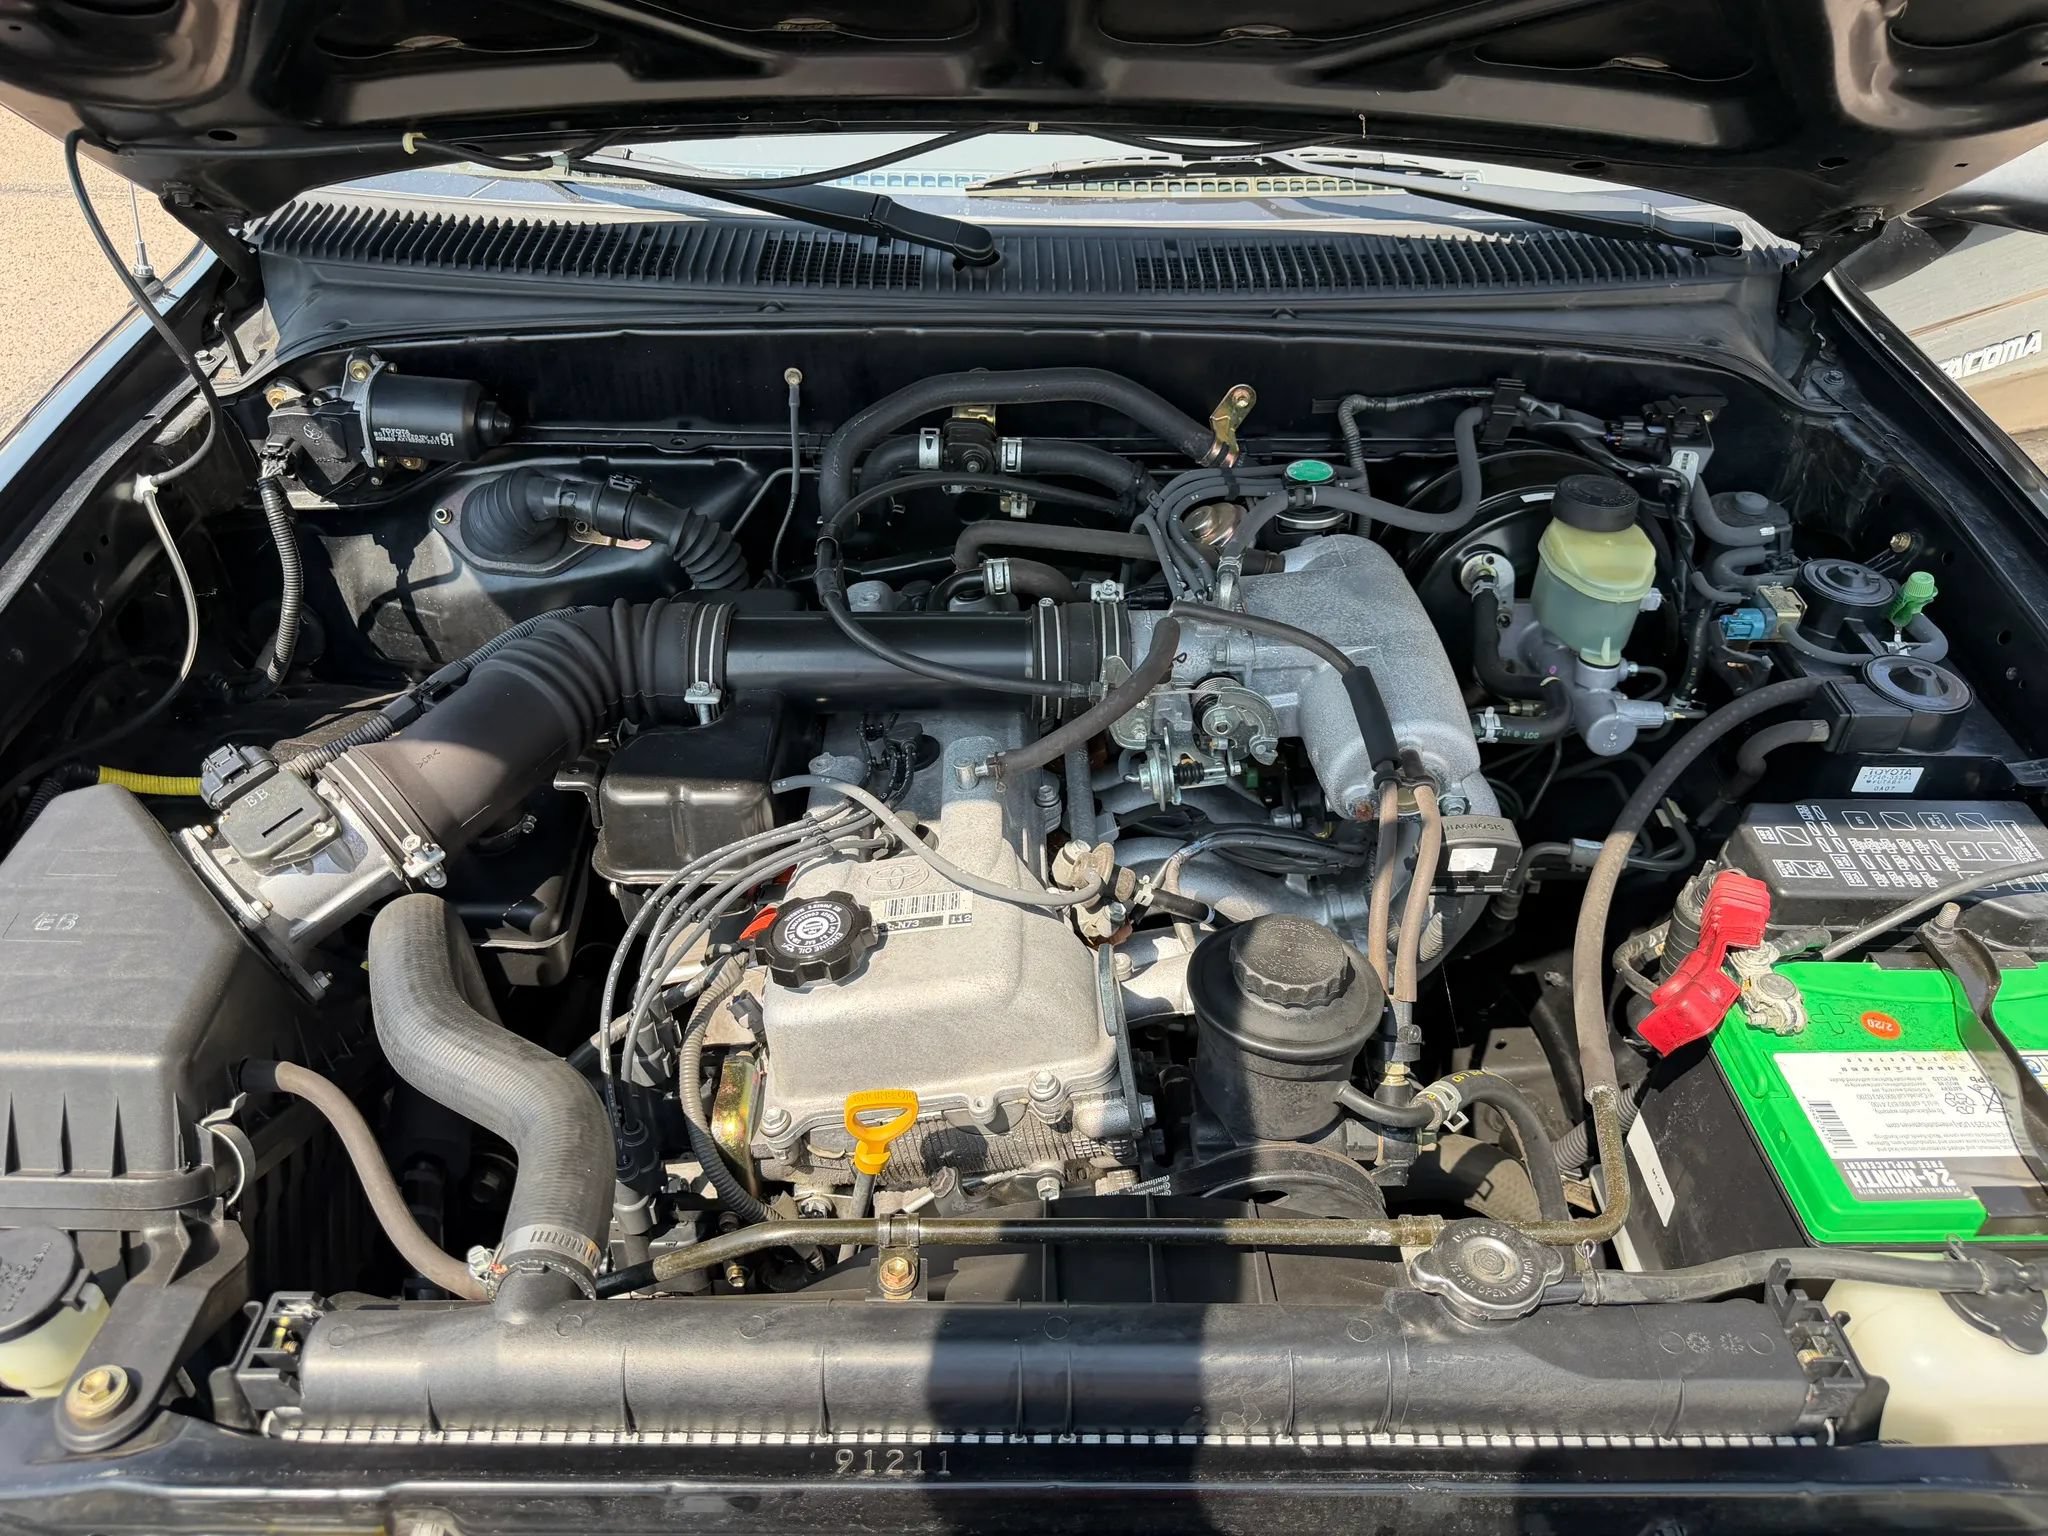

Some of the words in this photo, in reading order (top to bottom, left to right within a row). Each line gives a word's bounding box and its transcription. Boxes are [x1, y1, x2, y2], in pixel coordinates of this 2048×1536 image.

[440, 432, 454, 446] 91
[244, 788, 270, 808] EB
[950, 914, 972, 923] 112
[814, 932, 844, 953] ENGINE
[1842, 1160, 1913, 1170] REPLACEMENT
[1916, 1160, 1944, 1169] FREE
[1846, 1168, 1956, 1188] 24-MONTH
[1452, 1226, 1509, 1243] DANGER
[1449, 1260, 1476, 1289] NEVER
[1478, 1285, 1508, 1298] OPEN
[836, 1448, 951, 1476] 91211
